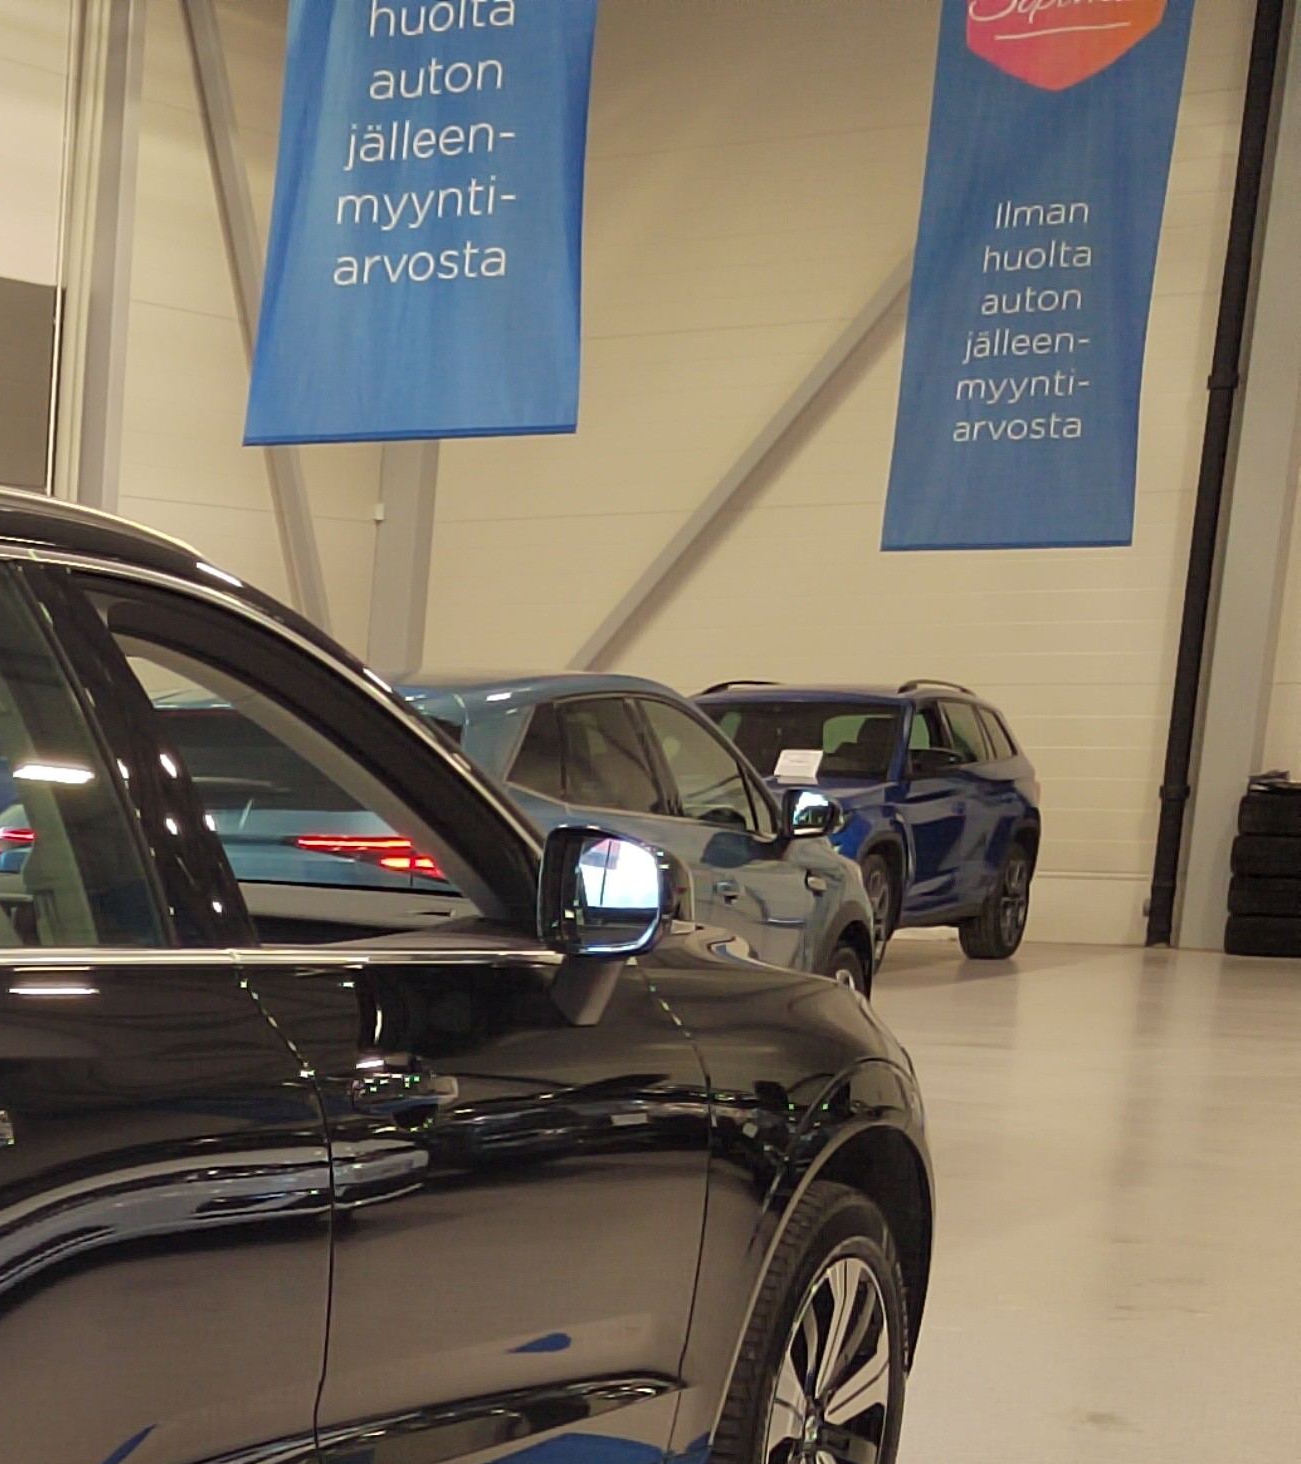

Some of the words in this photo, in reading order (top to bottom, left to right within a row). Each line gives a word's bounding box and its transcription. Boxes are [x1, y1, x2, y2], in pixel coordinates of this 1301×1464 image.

[369, 0, 515, 37] huolta
[369, 57, 504, 101] auton
[343, 120, 517, 170] jälleen-
[336, 175, 517, 231] myynti-
[995, 200, 1089, 230] Ilman
[333, 240, 507, 286] arvosta
[982, 240, 1093, 273] huolta
[980, 286, 1082, 315] auton
[962, 329, 1090, 364] jälleen-
[956, 367, 1090, 404] myynti-
[952, 411, 1083, 443] arvosta
